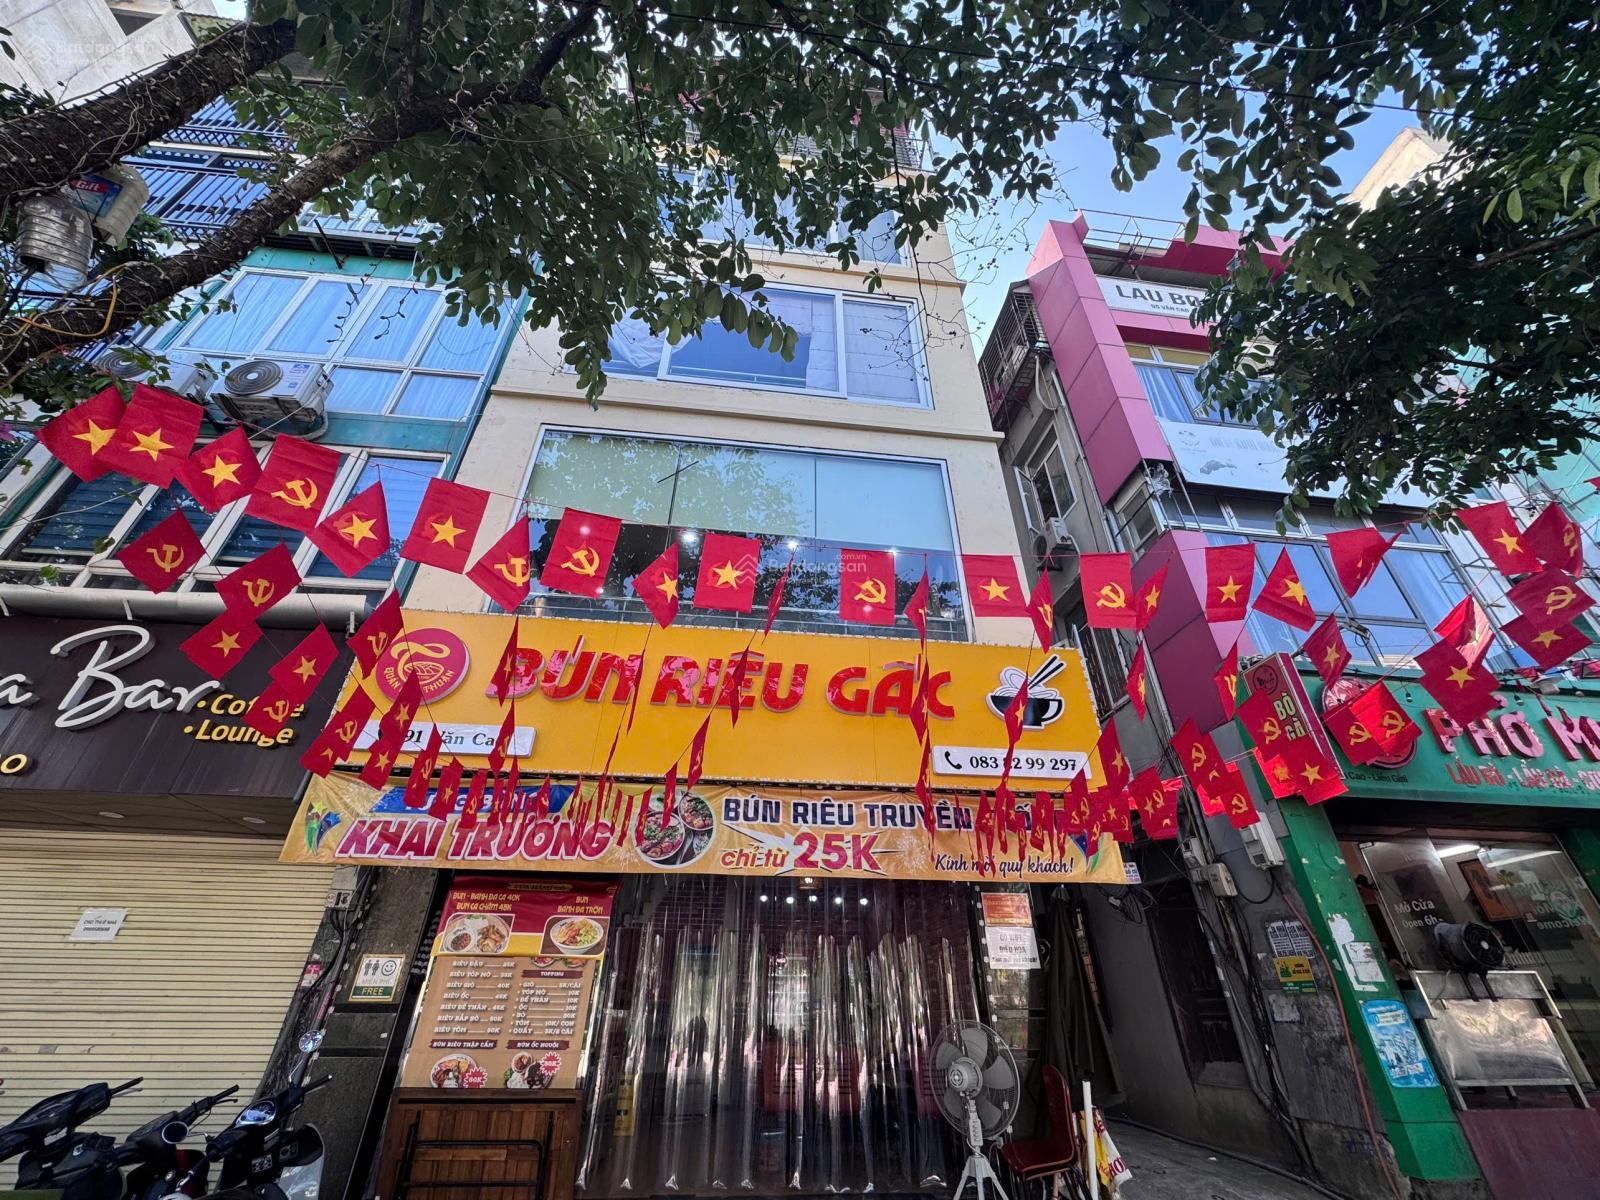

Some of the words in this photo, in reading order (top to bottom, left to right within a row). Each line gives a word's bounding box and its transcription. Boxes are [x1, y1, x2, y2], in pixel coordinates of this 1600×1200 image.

[50, 624, 222, 728] Bar
[649, 651, 809, 713] RIÊU
[1273, 692, 1296, 720] BÒ
[969, 756, 999, 769] 083
[1025, 757, 1045, 770] 99
[1050, 758, 1077, 771] 297
[723, 794, 782, 824] BÚN
[792, 797, 855, 827] RIÊU
[336, 818, 448, 861] KHAI
[793, 831, 881, 871] 25K
[934, 853, 968, 872] Kính
[362, 987, 384, 996] FREE
